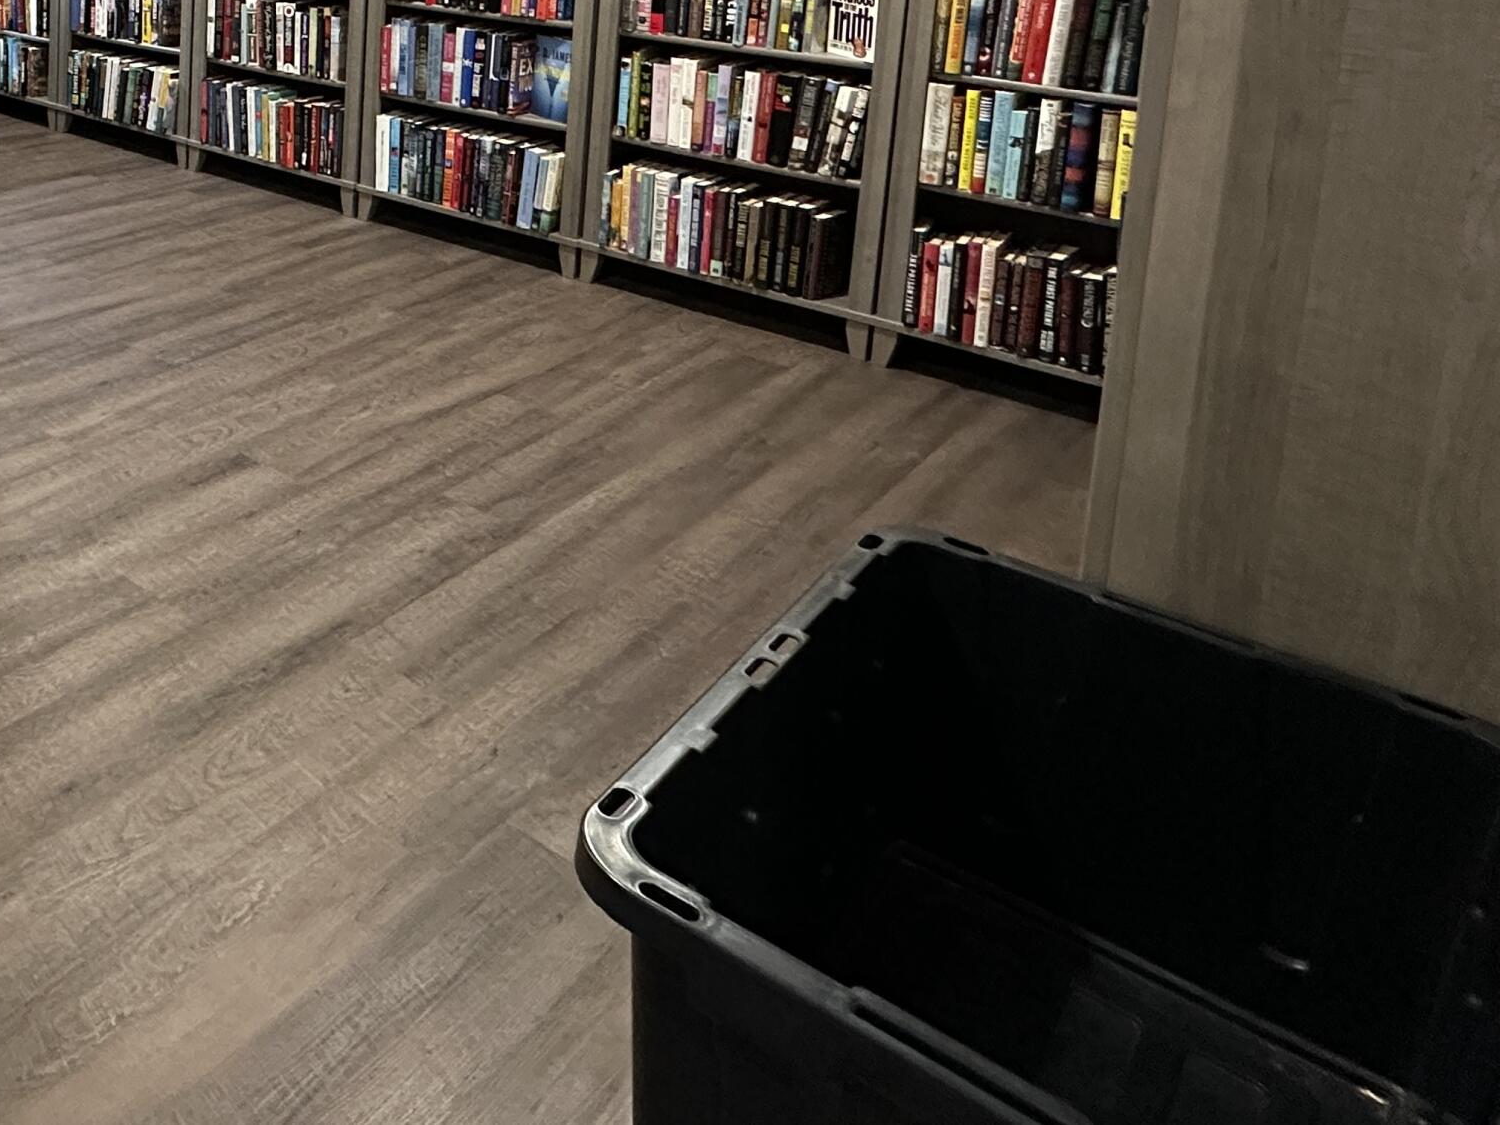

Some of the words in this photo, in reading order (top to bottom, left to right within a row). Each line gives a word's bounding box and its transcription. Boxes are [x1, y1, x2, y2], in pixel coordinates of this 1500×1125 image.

[725, 1, 737, 27] COOL
[832, 1, 874, 49] Truth
[906, 268, 917, 295] POISON
[1046, 280, 1056, 300] FIRST
[1043, 300, 1055, 327] PATIENT
